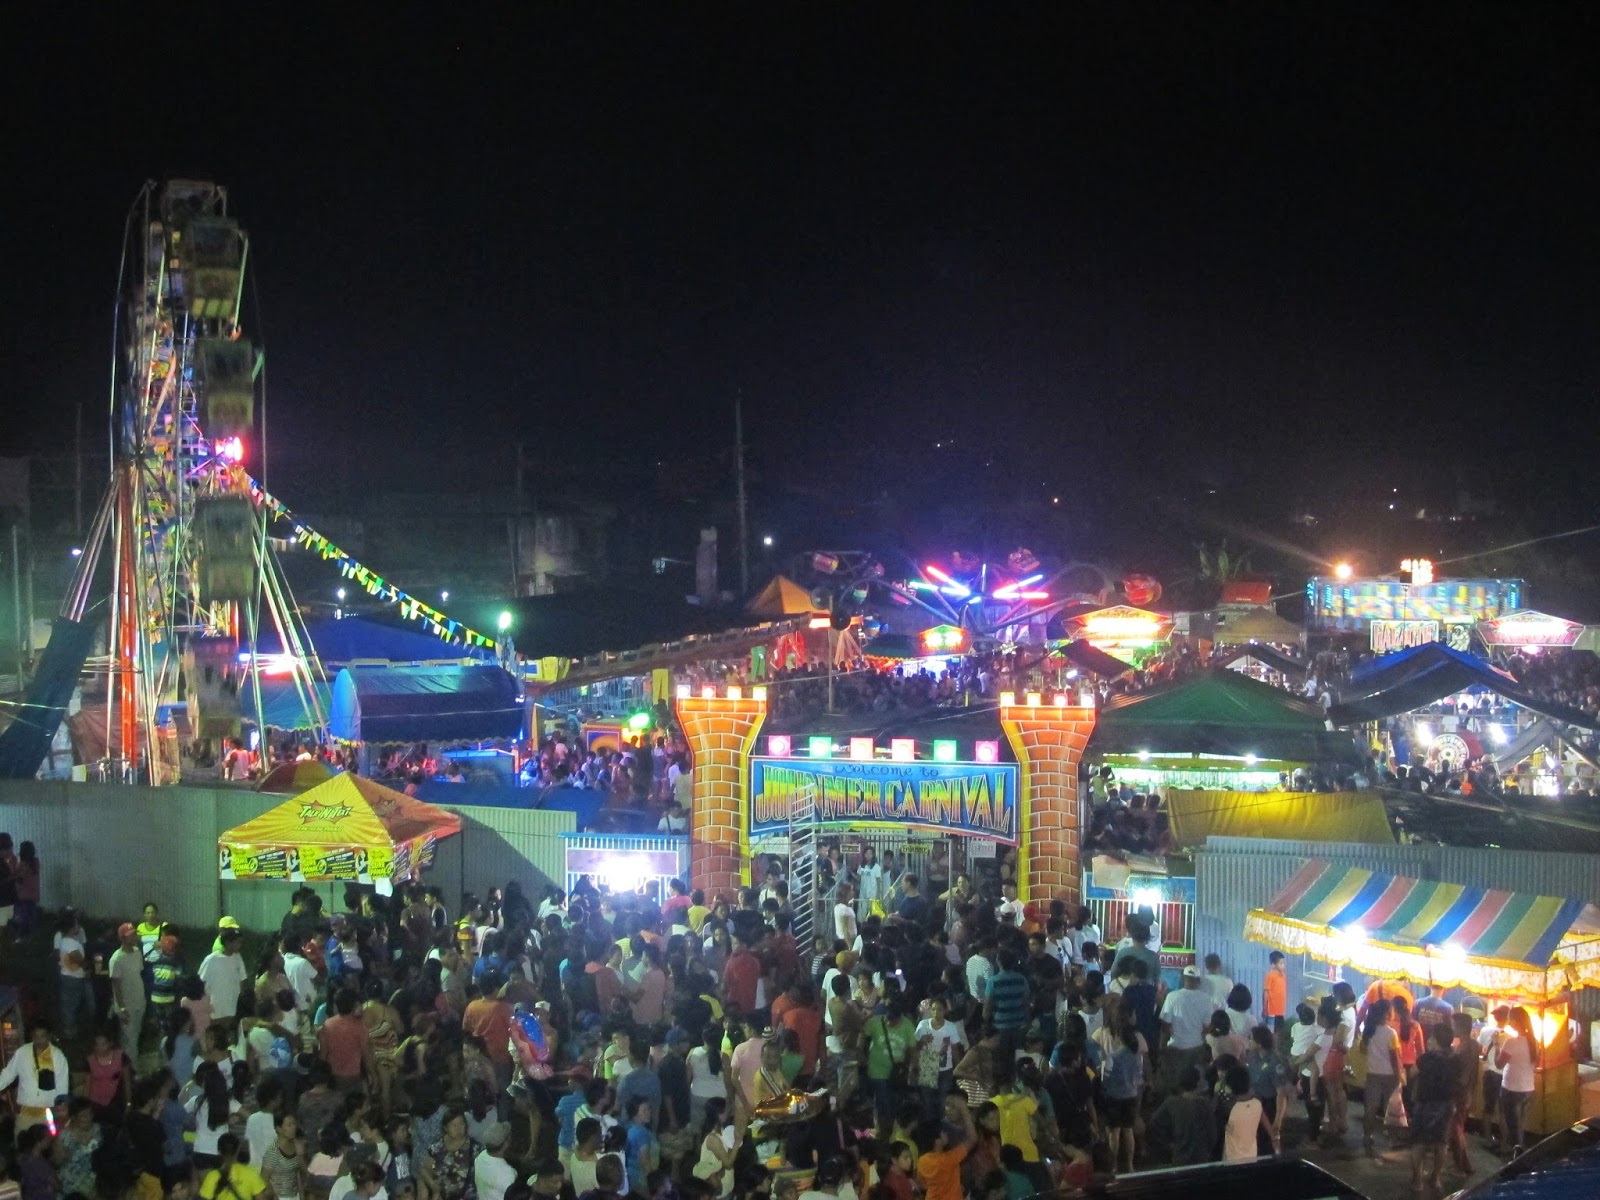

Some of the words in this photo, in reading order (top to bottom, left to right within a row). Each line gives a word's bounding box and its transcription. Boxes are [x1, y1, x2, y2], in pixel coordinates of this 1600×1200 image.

[920, 766, 939, 777] to
[884, 772, 1011, 834] CARNIVAL
[1159, 954, 1188, 965] OOTH
